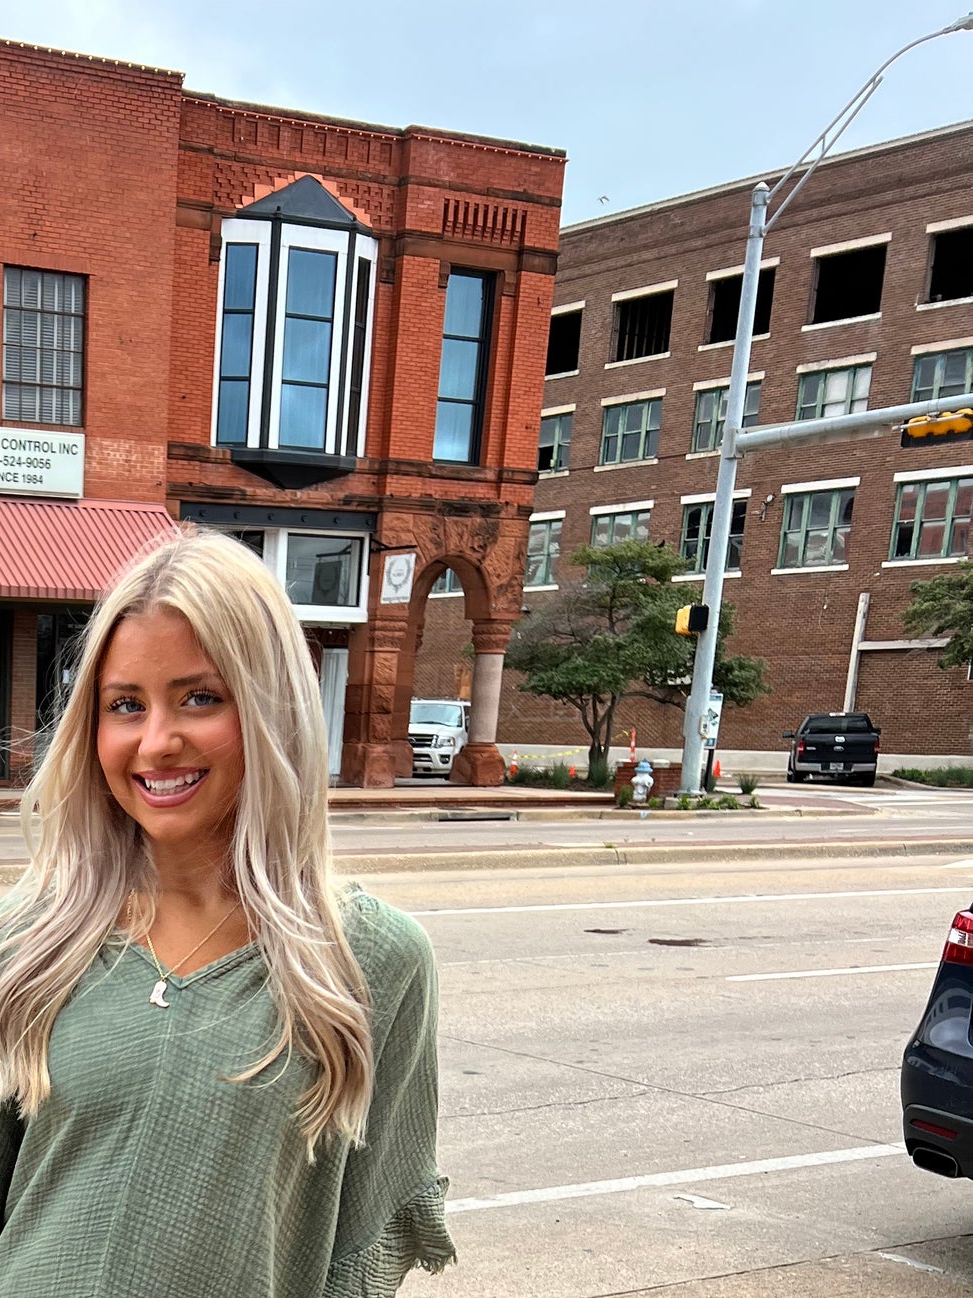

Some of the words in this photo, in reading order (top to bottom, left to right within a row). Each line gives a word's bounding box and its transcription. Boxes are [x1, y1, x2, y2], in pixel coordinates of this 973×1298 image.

[1, 438, 56, 454] CONTROL
[58, 443, 79, 456] INC
[22, 474, 44, 484] 1984
